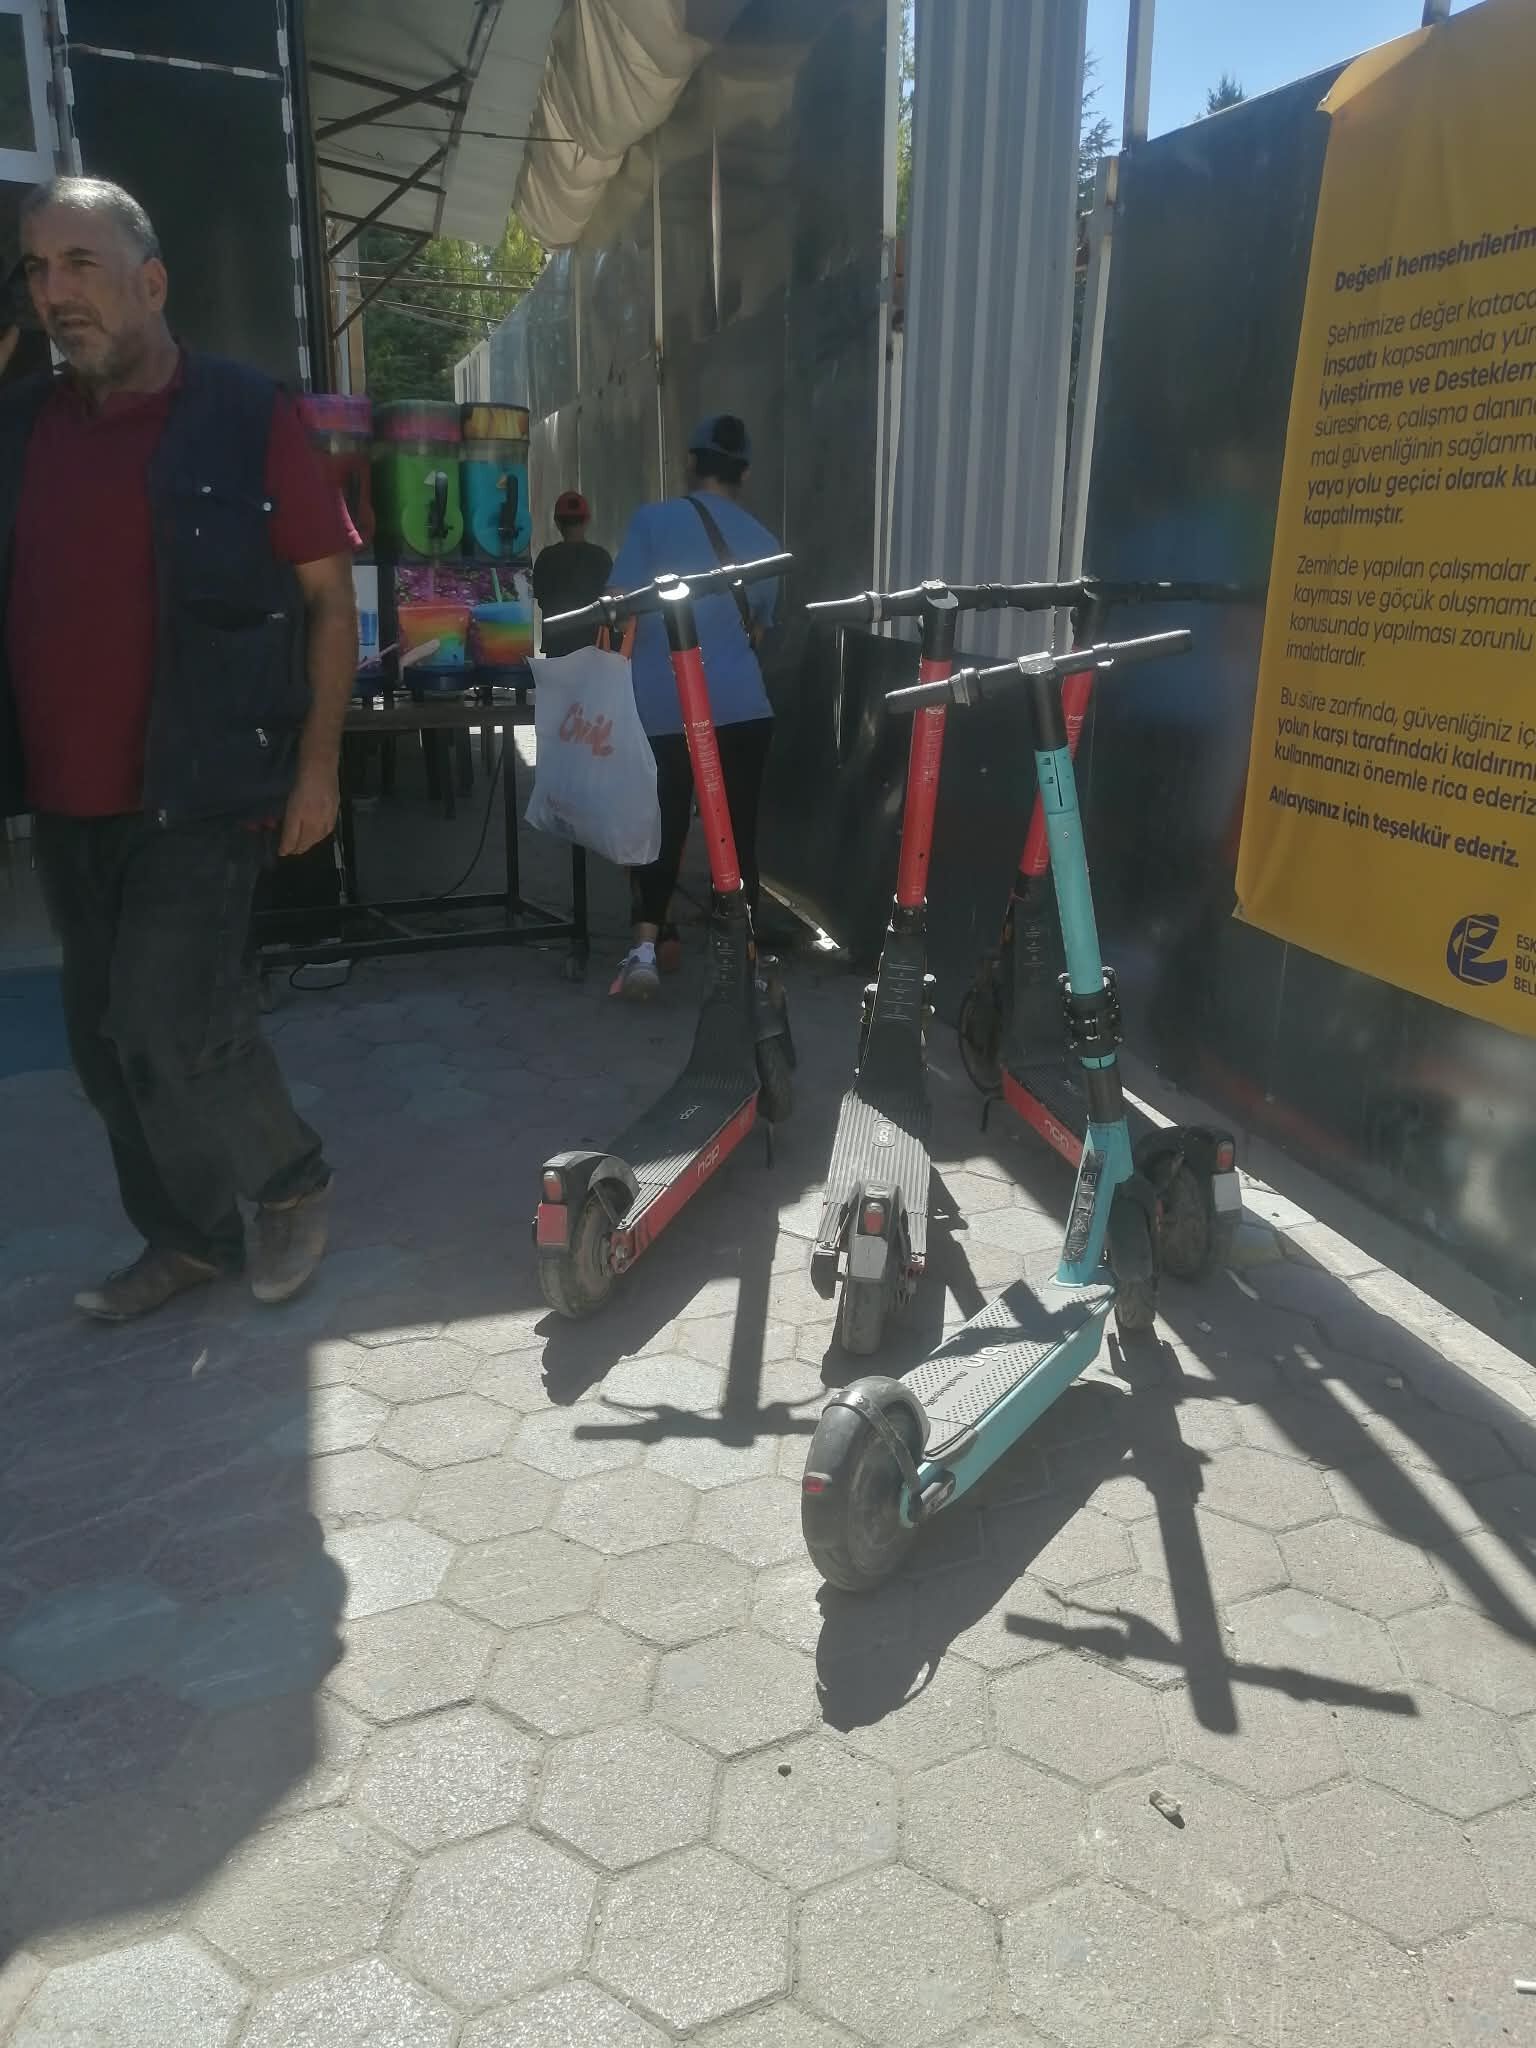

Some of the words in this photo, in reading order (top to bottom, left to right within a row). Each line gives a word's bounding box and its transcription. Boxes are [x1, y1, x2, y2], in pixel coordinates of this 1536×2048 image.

[1334, 256, 1392, 293] Değerli
[1328, 313, 1405, 347] Şehrimize
[1410, 300, 1463, 332] değer
[1382, 328, 1496, 367] kapsamında
[1409, 377, 1430, 395] ve
[1314, 411, 1392, 437] süresince,
[1397, 403, 1468, 431] çalışma
[1473, 395, 1536, 421] alanın
[1311, 446, 1340, 468] mal
[1342, 437, 1443, 469] güvenliğinin
[1447, 431, 1536, 461] sağlanm
[1307, 477, 1344, 500] yaya
[1346, 471, 1381, 498] yolu
[1385, 467, 1441, 497] geçici
[1445, 464, 1508, 491] olarak
[1303, 503, 1404, 528] kapatılmıştır.
[1296, 555, 1359, 577] Zeminde
[1362, 556, 1424, 582] yapılan
[1429, 556, 1531, 583] çalışmalar
[1293, 584, 1352, 608] kayması
[1356, 589, 1376, 607] ve
[1379, 586, 1433, 613] göçük
[1289, 612, 1369, 638] konusunda
[1373, 618, 1456, 645] yapılması
[1460, 625, 1534, 652] zorunlu
[1286, 640, 1366, 667] imalatlardır.
[1280, 687, 1297, 706] Bu
[1297, 689, 1327, 711] süre
[1403, 707, 1513, 743] güvenliğiniz
[1517, 720, 1536, 749] iç
[1277, 715, 1309, 739] yolun
[1312, 724, 1349, 747] karşı
[1352, 728, 1449, 764] tarafındaki
[1274, 740, 1360, 777] kullanmanızı
[1363, 762, 1428, 792] önemle
[1431, 774, 1468, 801] rica
[1269, 784, 1340, 820] Anlayışınız
[1343, 802, 1369, 829] için
[1373, 811, 1450, 849] teşekkür
[1455, 833, 1519, 868] ederiz.
